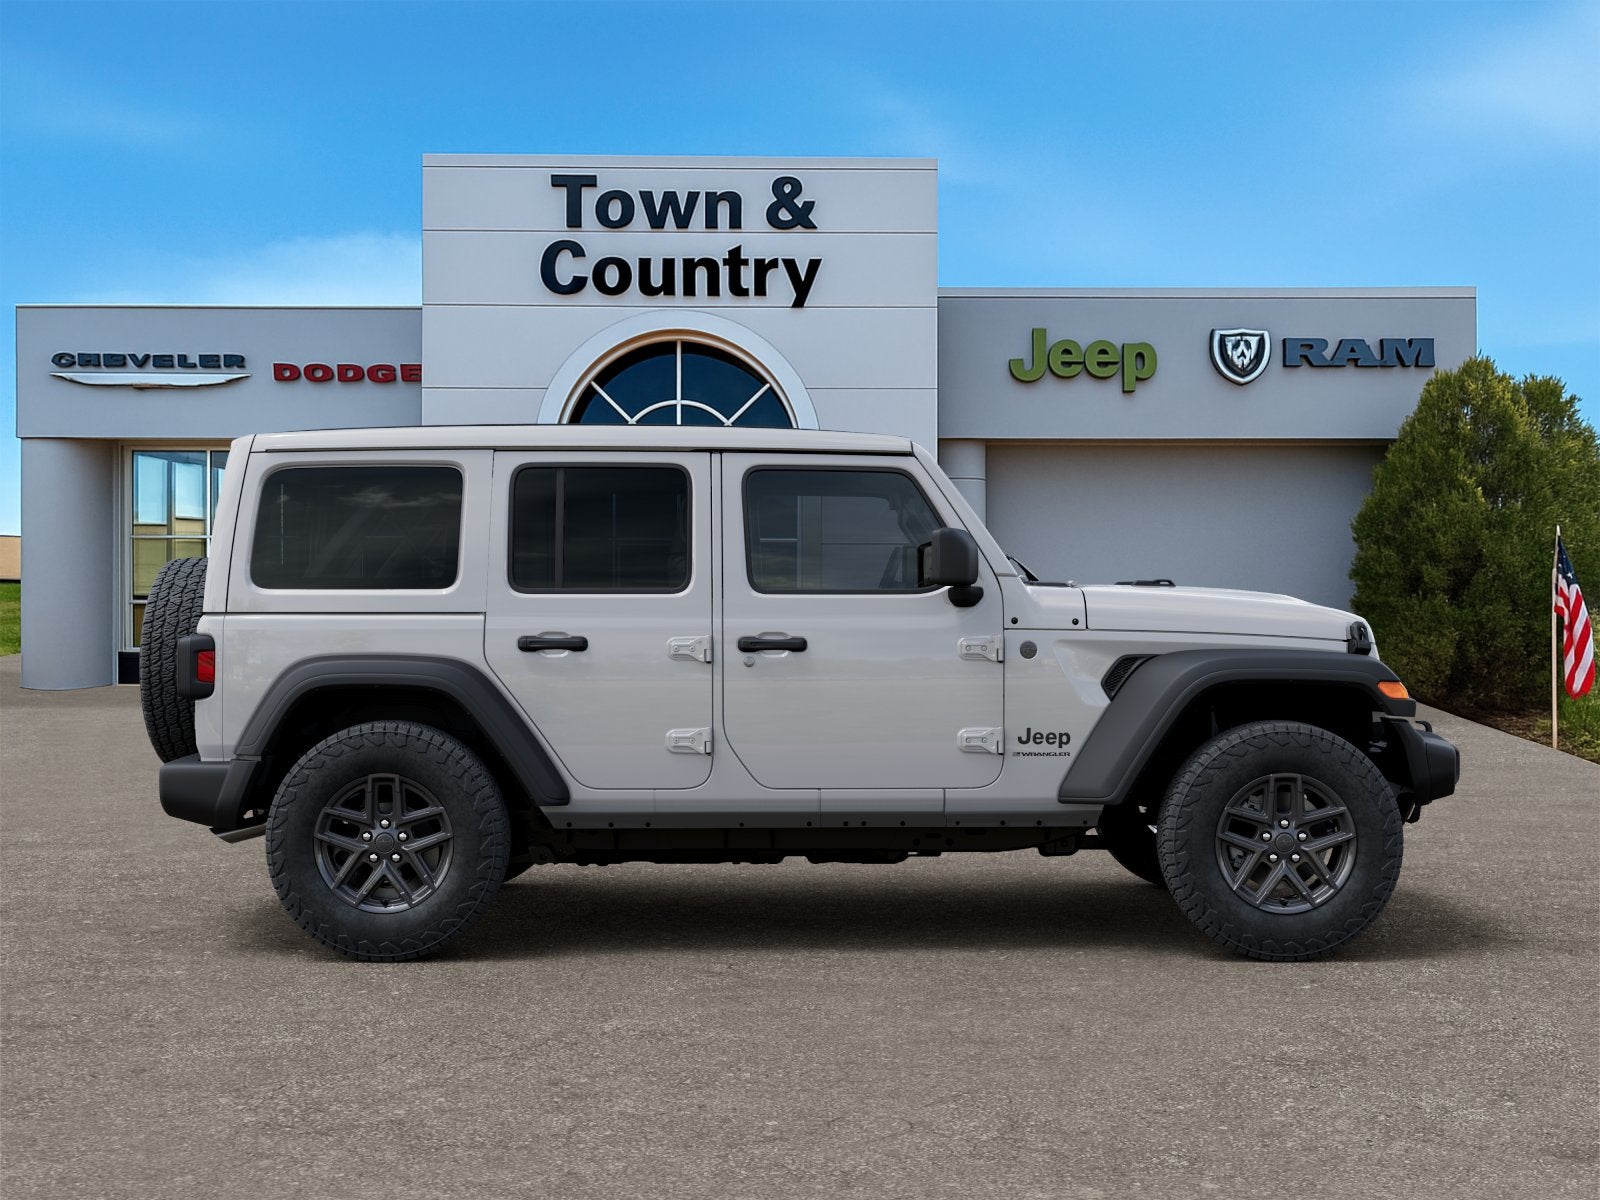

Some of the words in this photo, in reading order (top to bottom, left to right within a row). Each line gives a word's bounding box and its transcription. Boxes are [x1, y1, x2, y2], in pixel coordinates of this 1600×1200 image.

[551, 174, 742, 229] Town
[765, 176, 818, 229] &
[540, 239, 822, 308] Country
[273, 363, 422, 383] DODGE
[1009, 328, 1157, 393] Jeep
[1282, 337, 1435, 368] RAM
[1017, 727, 1071, 749] Jeep
